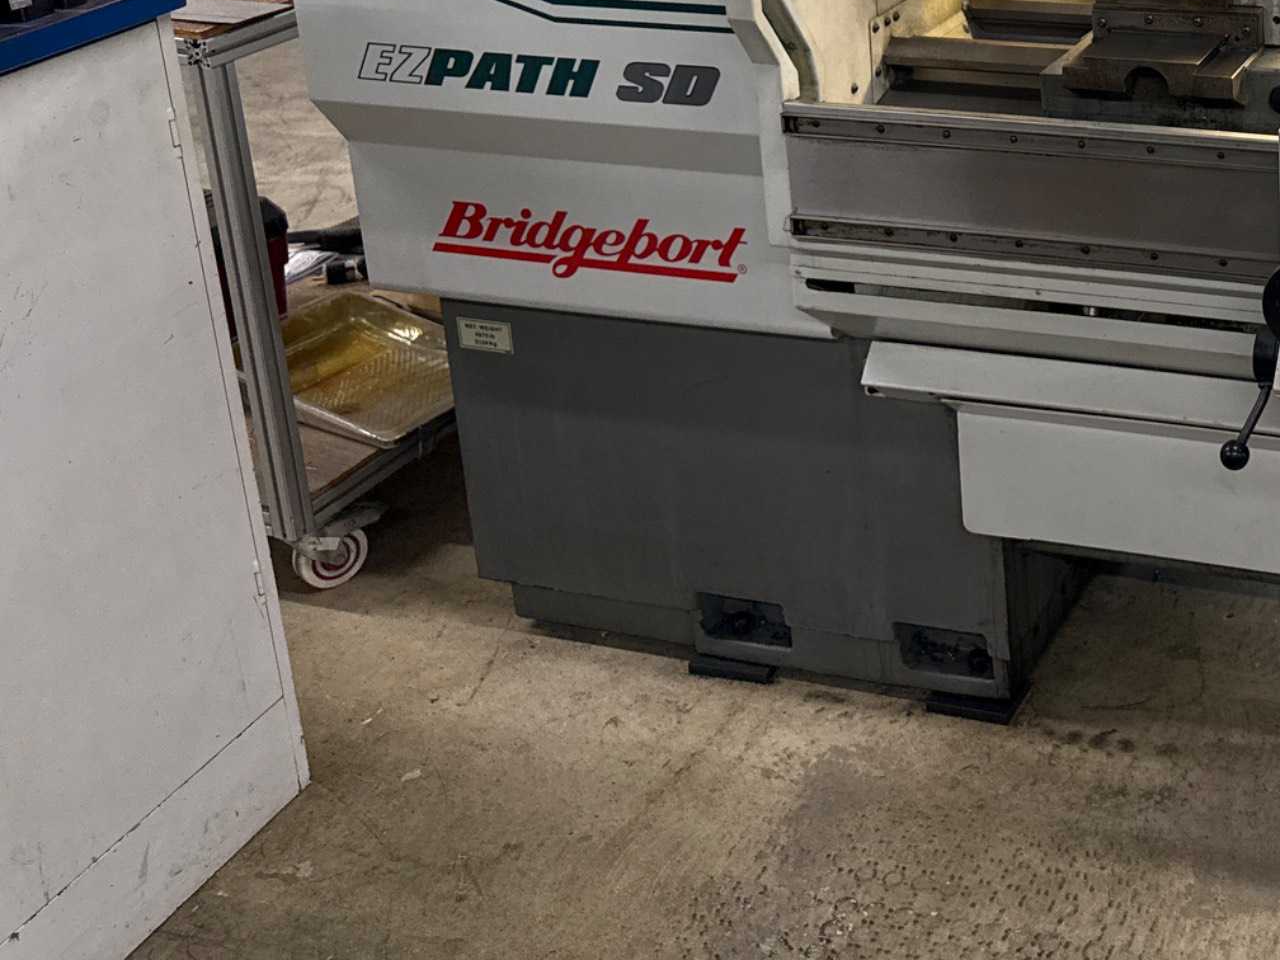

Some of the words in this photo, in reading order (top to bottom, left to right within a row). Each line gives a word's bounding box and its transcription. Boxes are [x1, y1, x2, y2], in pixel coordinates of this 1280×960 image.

[357, 41, 600, 98] EZPATH
[616, 61, 721, 106] SD
[438, 200, 748, 278] Bridgeport
